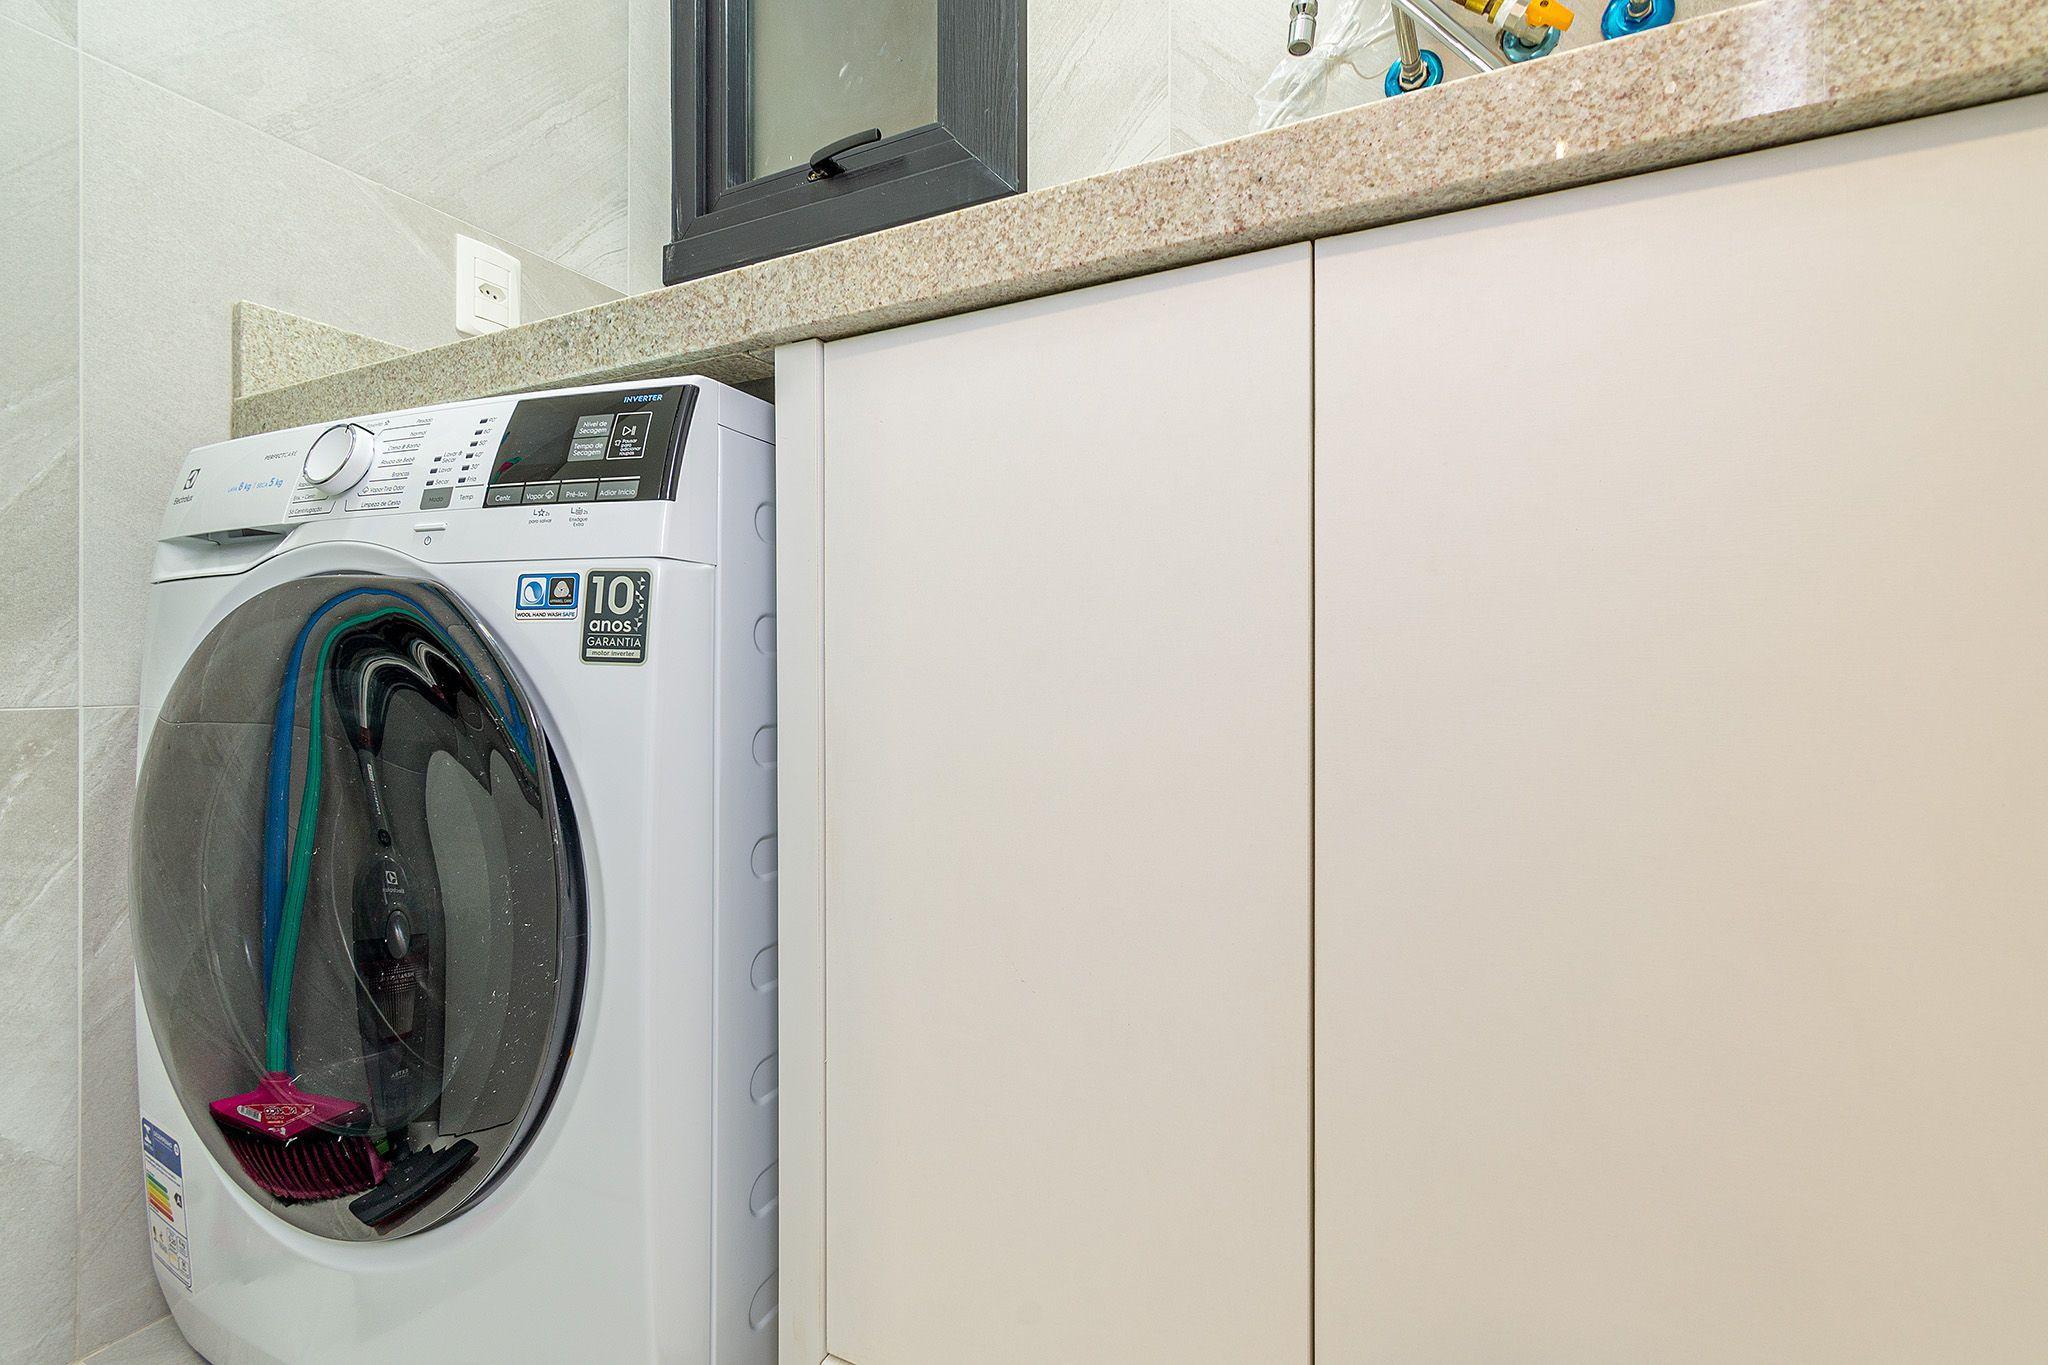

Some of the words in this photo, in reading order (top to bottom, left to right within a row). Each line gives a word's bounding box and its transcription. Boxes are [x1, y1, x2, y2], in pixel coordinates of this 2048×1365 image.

[623, 394, 663, 404] INVERTER
[578, 427, 608, 435] Secagem
[574, 442, 595, 450] Tempo
[572, 449, 602, 457] Secagem
[268, 476, 276, 487] 5
[276, 479, 284, 489] kg
[526, 493, 544, 501] Vapor
[592, 575, 635, 615] 10
[589, 619, 632, 633] anos
[586, 636, 642, 648] GARANTIA
